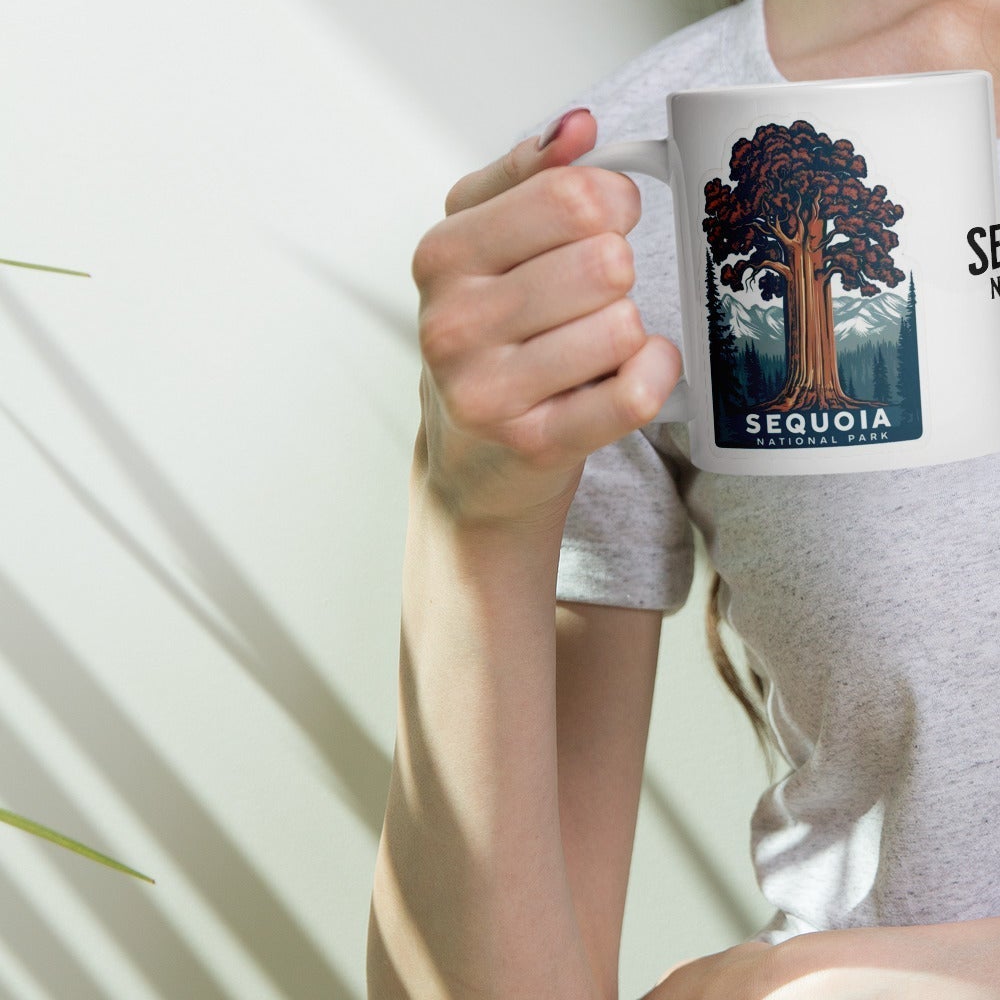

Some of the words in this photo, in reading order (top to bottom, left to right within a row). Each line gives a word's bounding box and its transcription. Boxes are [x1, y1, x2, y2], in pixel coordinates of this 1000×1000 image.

[745, 408, 892, 434] SEQUOIA
[756, 435, 838, 446] NATIONAL
[848, 431, 889, 443] PARK
